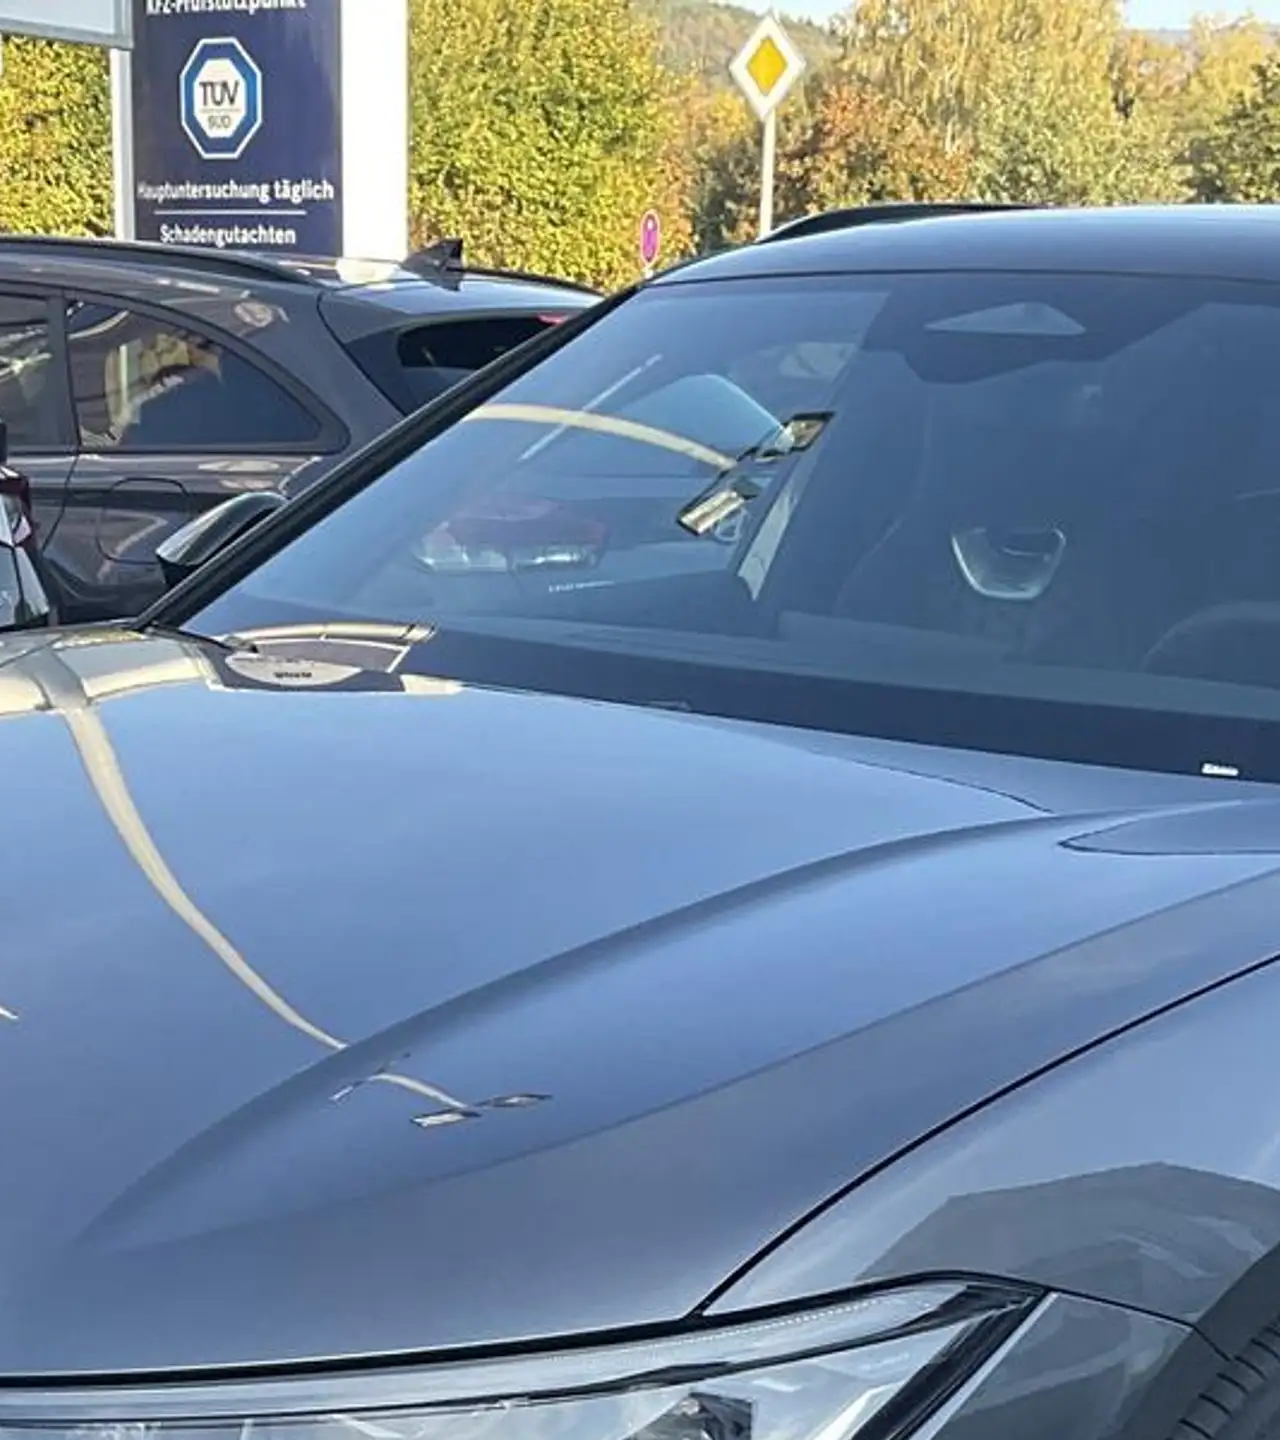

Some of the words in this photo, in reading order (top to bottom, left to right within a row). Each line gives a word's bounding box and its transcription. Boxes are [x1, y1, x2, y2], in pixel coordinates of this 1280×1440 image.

[199, 79, 240, 107] TÜV
[137, 179, 269, 204] Hauptuntersuchung
[273, 178, 335, 202] täglich
[160, 223, 296, 246] Schadengutachten
